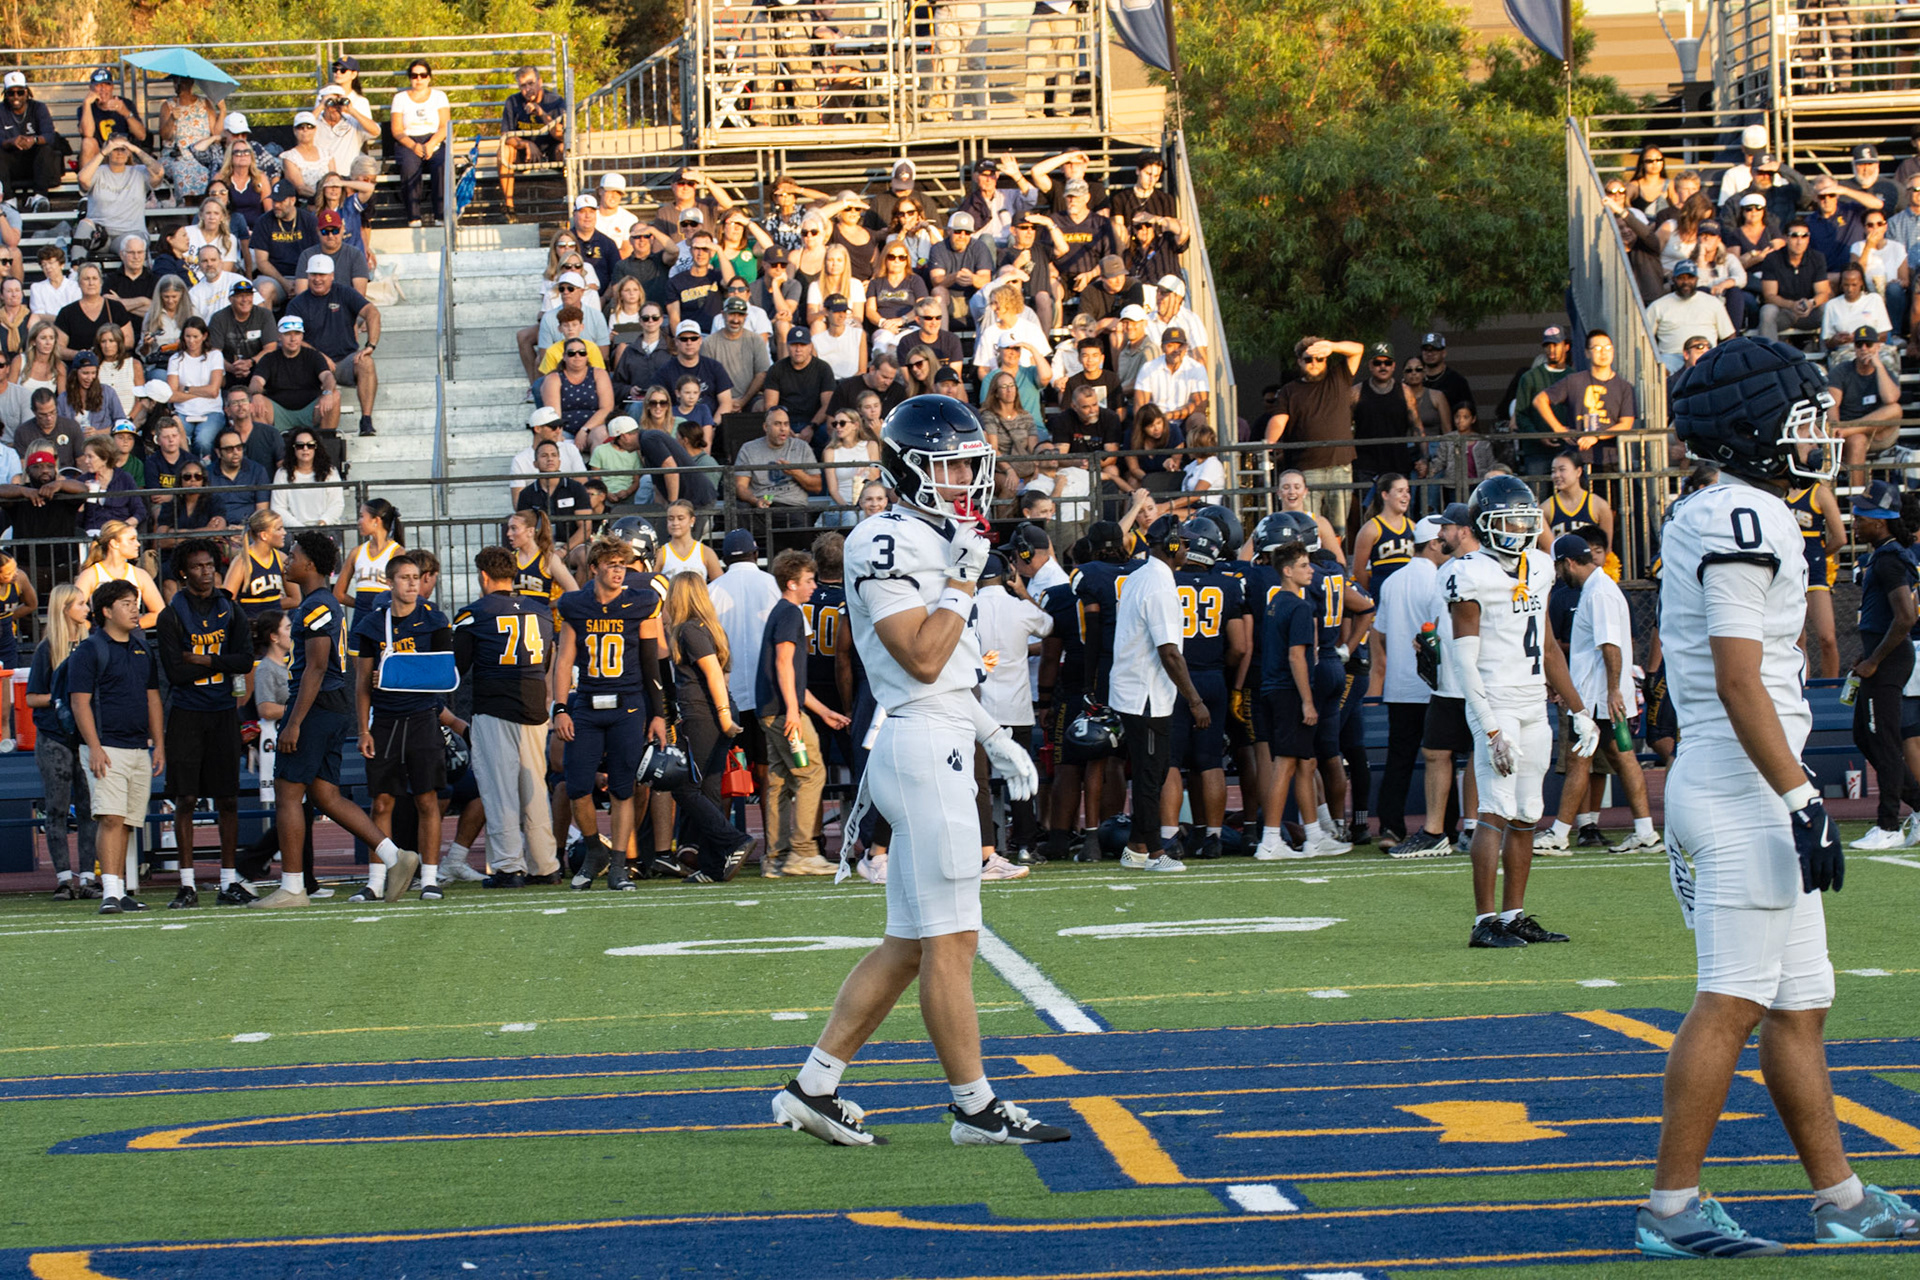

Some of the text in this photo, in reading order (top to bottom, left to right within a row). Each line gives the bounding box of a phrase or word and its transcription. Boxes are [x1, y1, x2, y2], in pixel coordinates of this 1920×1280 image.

[272, 232, 303, 242] SAINTS
[963, 442, 983, 450] Riddell
[1730, 507, 1762, 550] 0
[872, 534, 895, 570] 3
[513, 573, 544, 592] LHS
[1446, 574, 1458, 598] 4
[1321, 574, 1344, 628] 17
[191, 629, 226, 645] SAINTS
[496, 613, 544, 665] 74
[586, 619, 624, 633] SAINTS
[585, 633, 625, 678] 10
[1523, 615, 1542, 675] 4
